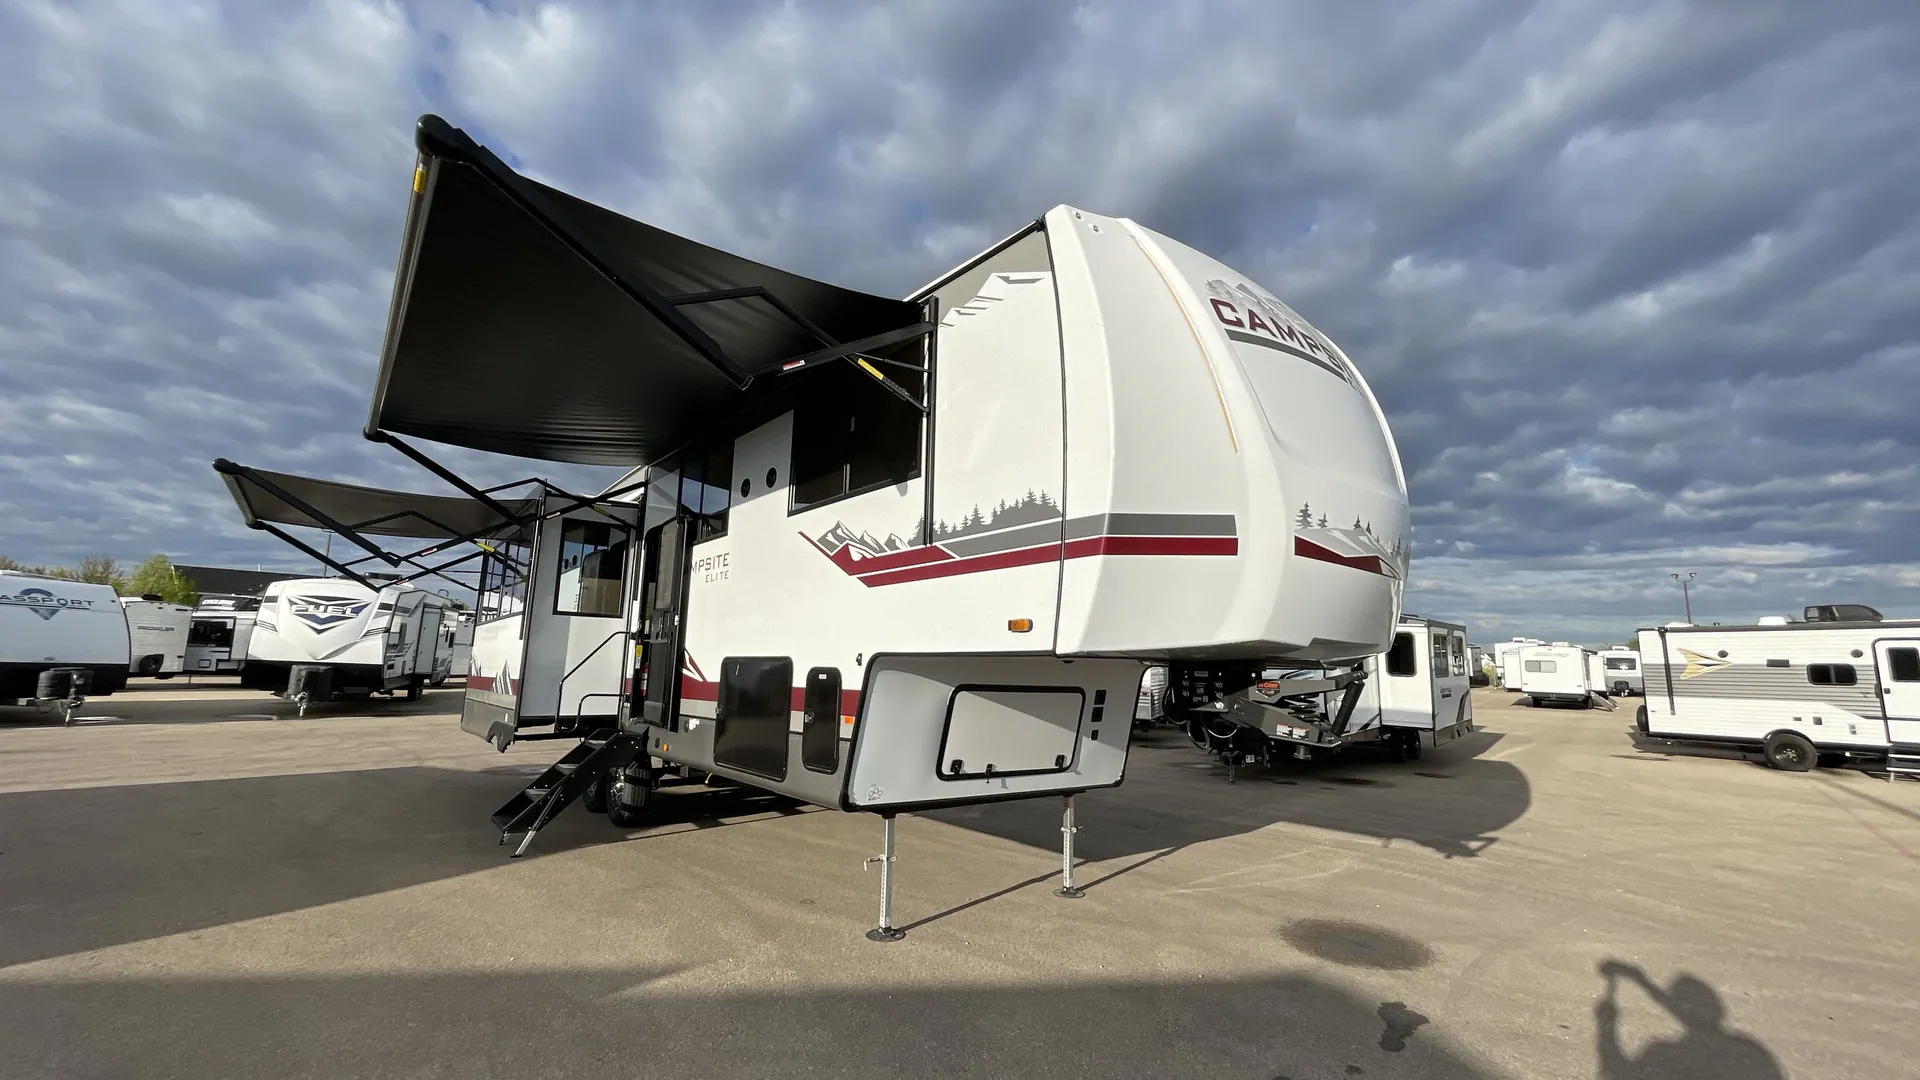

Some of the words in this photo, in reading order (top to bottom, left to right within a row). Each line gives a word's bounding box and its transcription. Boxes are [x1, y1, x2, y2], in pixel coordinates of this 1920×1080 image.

[691, 552, 730, 574] MPSITE
[705, 570, 729, 583] ELITE
[0, 594, 96, 608] ASSPORT
[291, 604, 358, 618] FUEL
